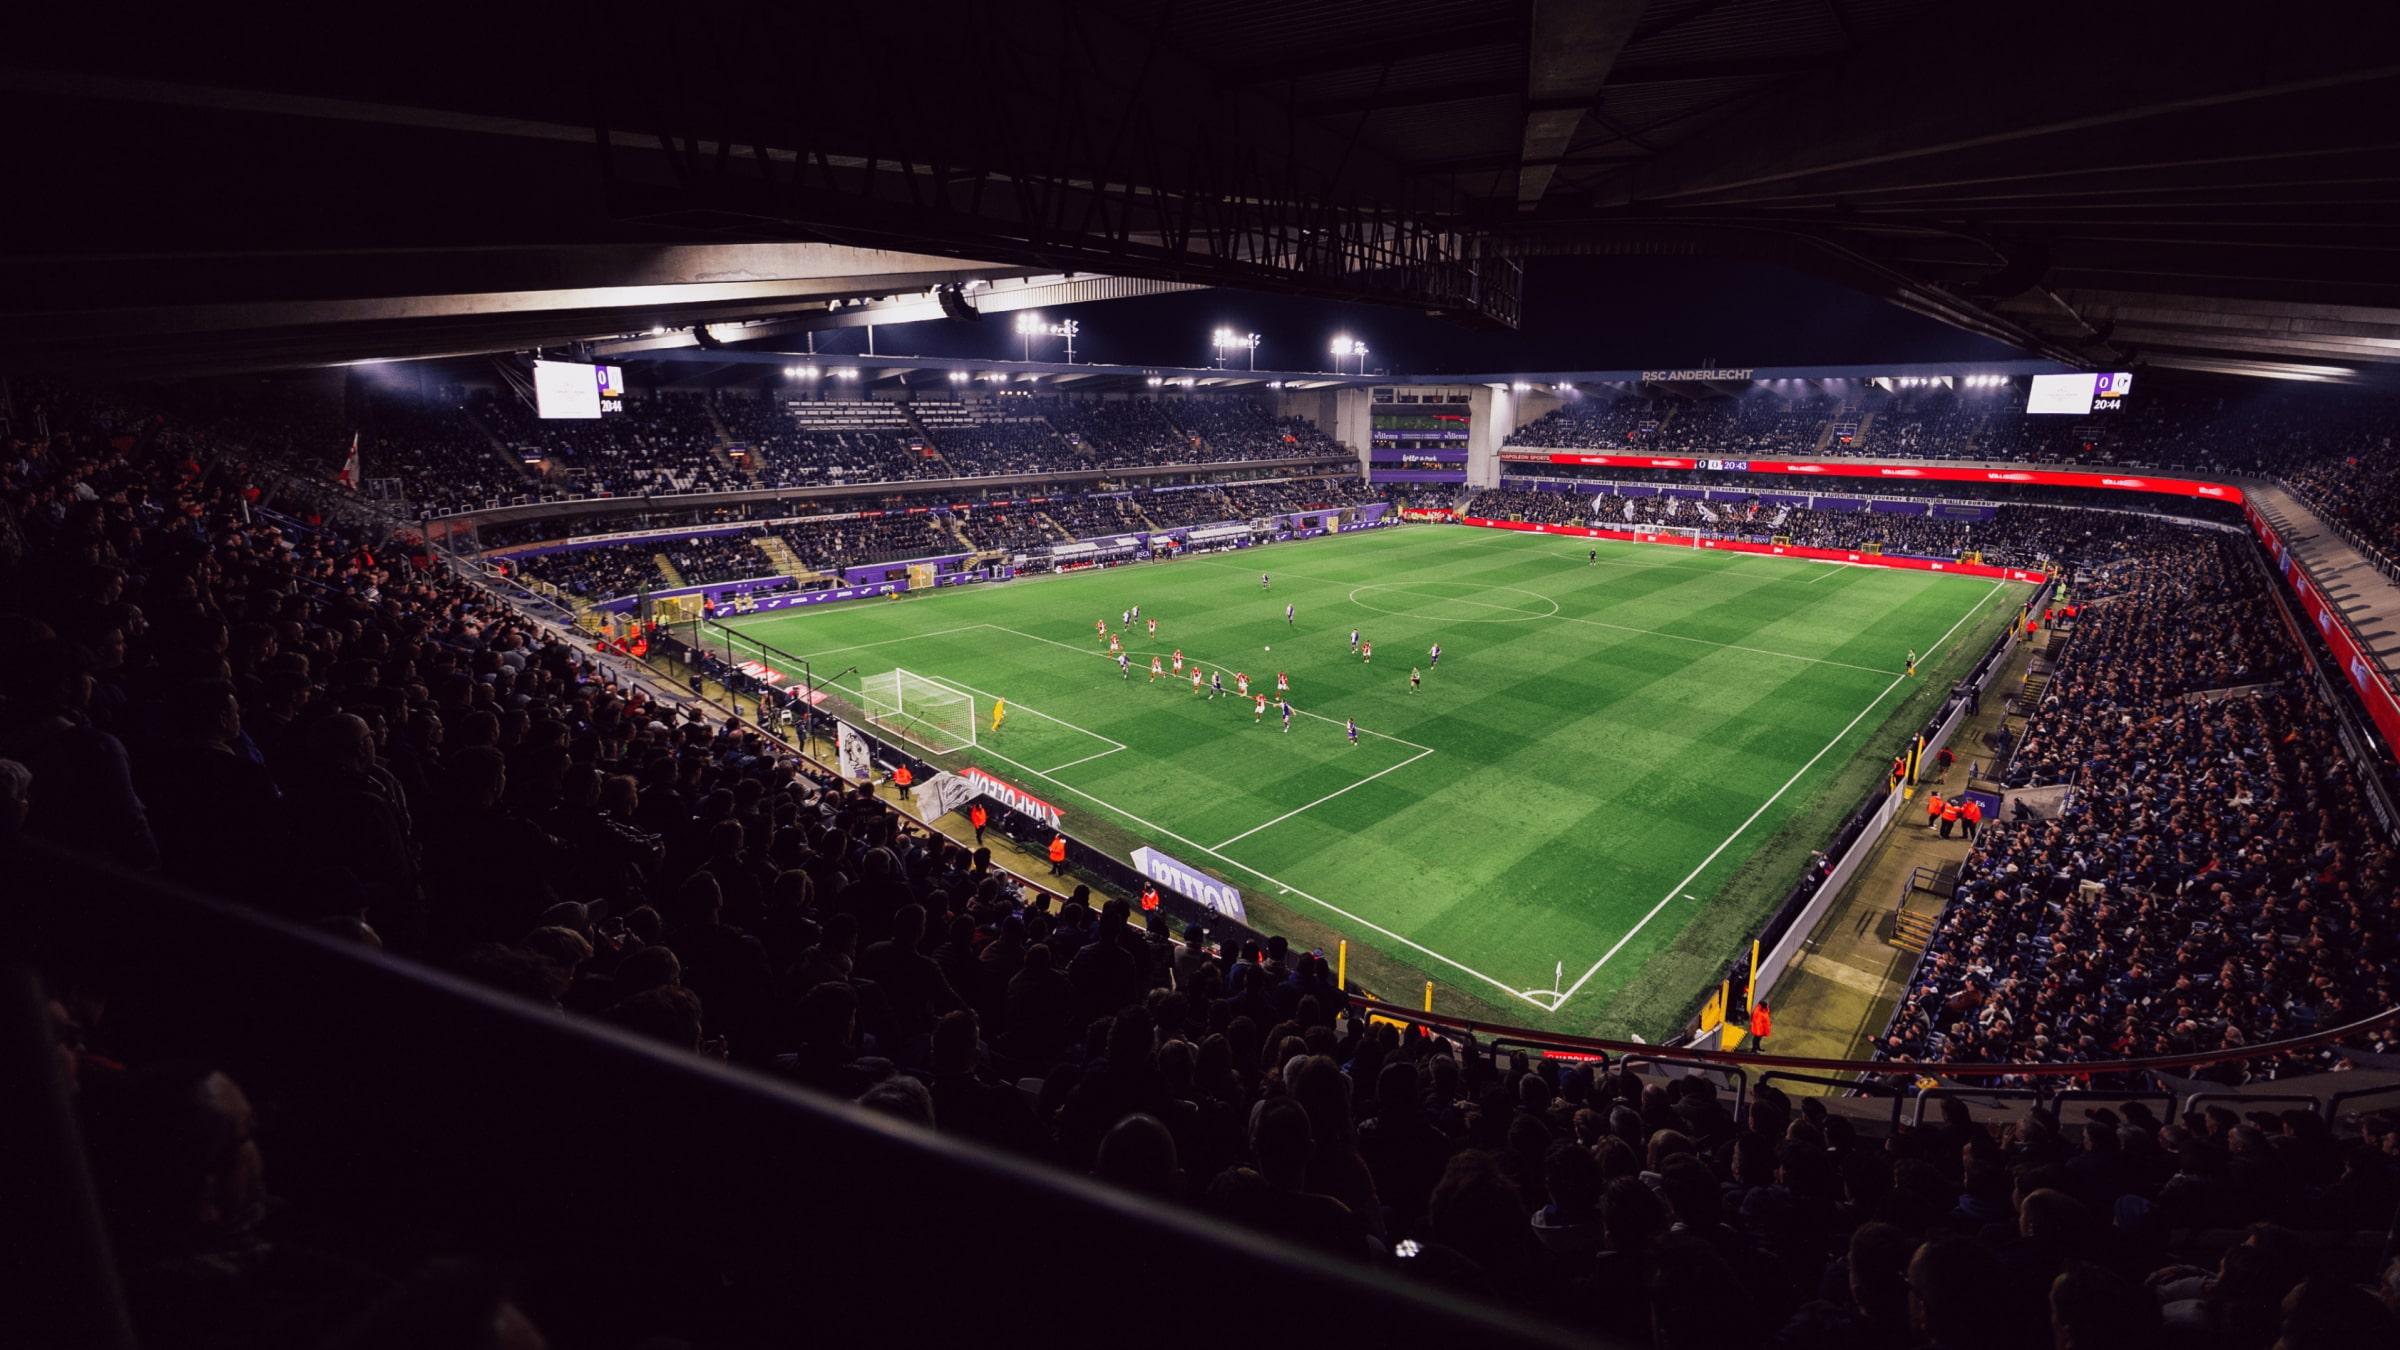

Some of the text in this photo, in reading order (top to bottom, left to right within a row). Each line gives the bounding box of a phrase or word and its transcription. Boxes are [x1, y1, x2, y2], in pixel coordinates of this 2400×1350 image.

[598, 370, 606, 385] 0
[1642, 369, 1753, 381] RSC ANDERLECHT
[2099, 377, 2109, 388] 0
[601, 400, 622, 412] 20:44
[2094, 399, 2120, 410] 20:44
[1374, 431, 1398, 439] willems
[1444, 431, 1468, 439] willems
[1698, 460, 1706, 468] 0
